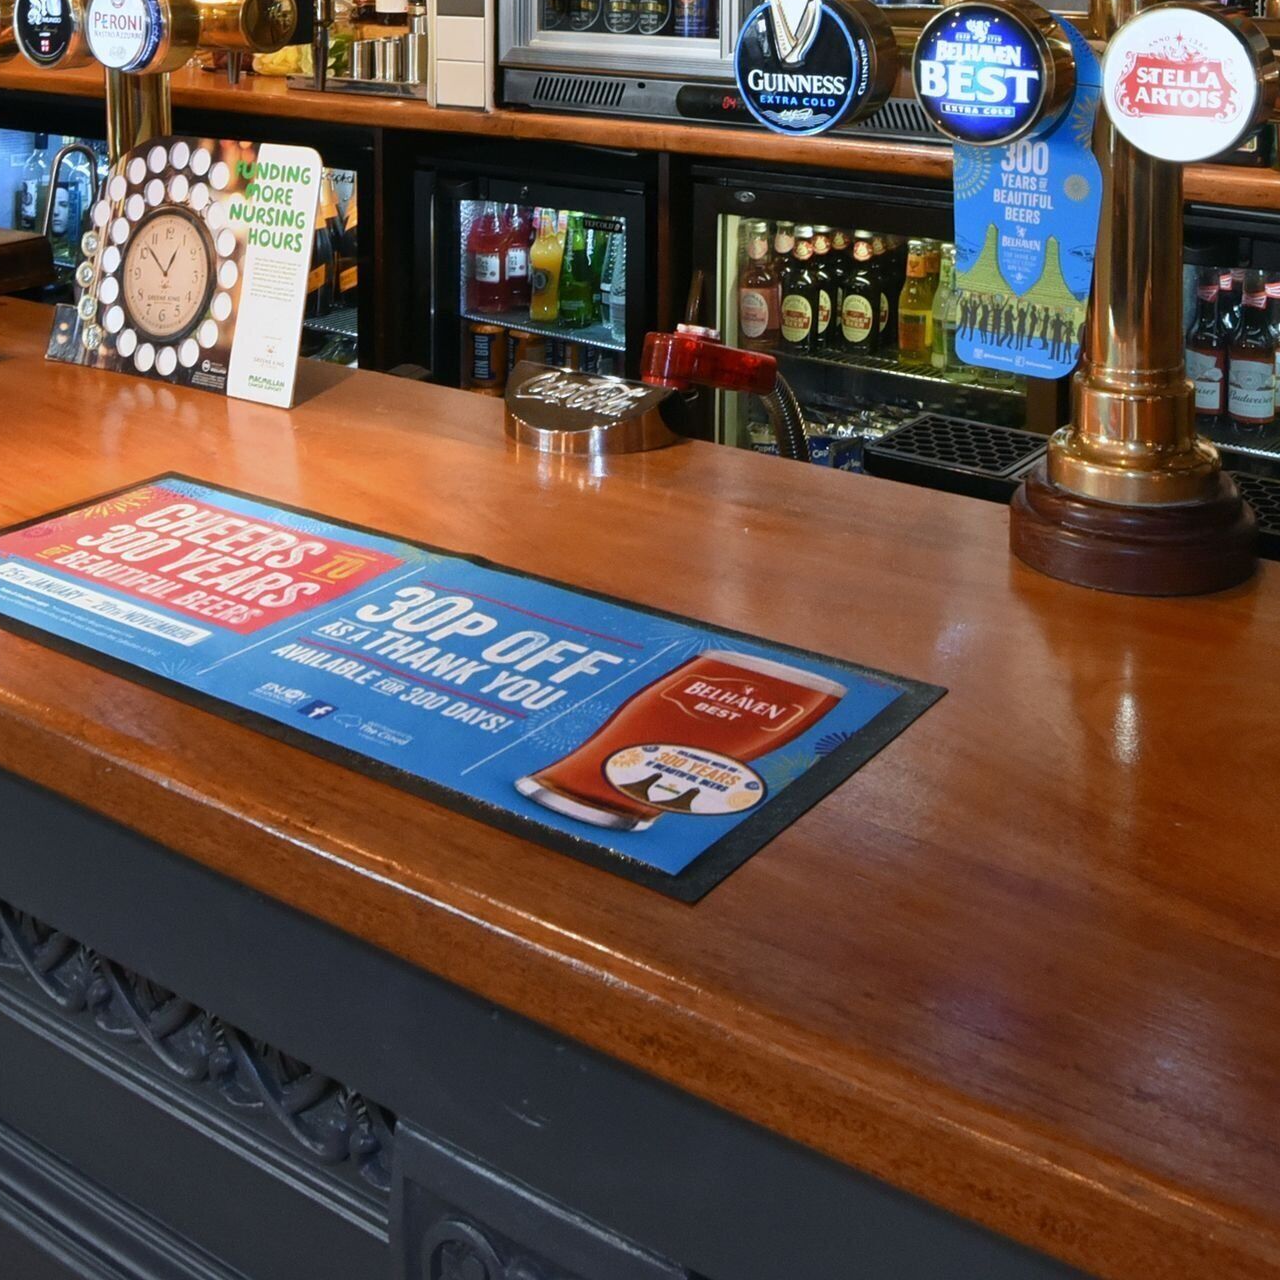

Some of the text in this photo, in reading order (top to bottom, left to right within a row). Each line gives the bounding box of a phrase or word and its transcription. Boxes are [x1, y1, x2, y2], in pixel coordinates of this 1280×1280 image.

[94, 11, 143, 31] PERONI
[935, 40, 1022, 67] BELHAVEN
[748, 69, 846, 96] GUINNESS
[920, 60, 1039, 104] BEST
[1136, 66, 1221, 90] STELLA
[760, 95, 836, 107] EXTRA COLD
[944, 104, 1012, 116] EXTRA COLD
[1135, 89, 1223, 110] ARTOIS
[1001, 139, 1049, 176] 300
[235, 161, 312, 185] FUNDING
[1001, 173, 1038, 191] YEARS
[245, 183, 294, 206] MORE
[993, 188, 1054, 210] BEAUTIFUL
[229, 203, 305, 229] NURSING
[1005, 207, 1041, 225] BEERS
[248, 228, 303, 253] HOURS
[1001, 235, 1042, 252] BELHAVEN
[248, 374, 285, 388] MACMILLAN
[1229, 390, 1274, 405] Budweiser
[133, 502, 368, 580] CHEERS TO
[75, 524, 322, 609] 300 YEARS
[54, 550, 181, 600] BEAUTIFUL
[179, 586, 265, 625] BEERS
[25, 575, 85, 601] JANUARY
[119, 607, 202, 642] NOVEMBER
[355, 586, 498, 645] 30P
[318, 620, 569, 711] AS A THANK YOU
[260, 681, 312, 702] ENJOY
[271, 643, 515, 734] AVAILABLE FOR 300 DAYS!
[683, 680, 787, 721] BELHAVEN
[694, 702, 742, 721] BEST
[359, 722, 376, 733] The
[651, 762, 730, 793] BEAUTIFUL BEERS
[653, 751, 742, 788] 300 YEARS
